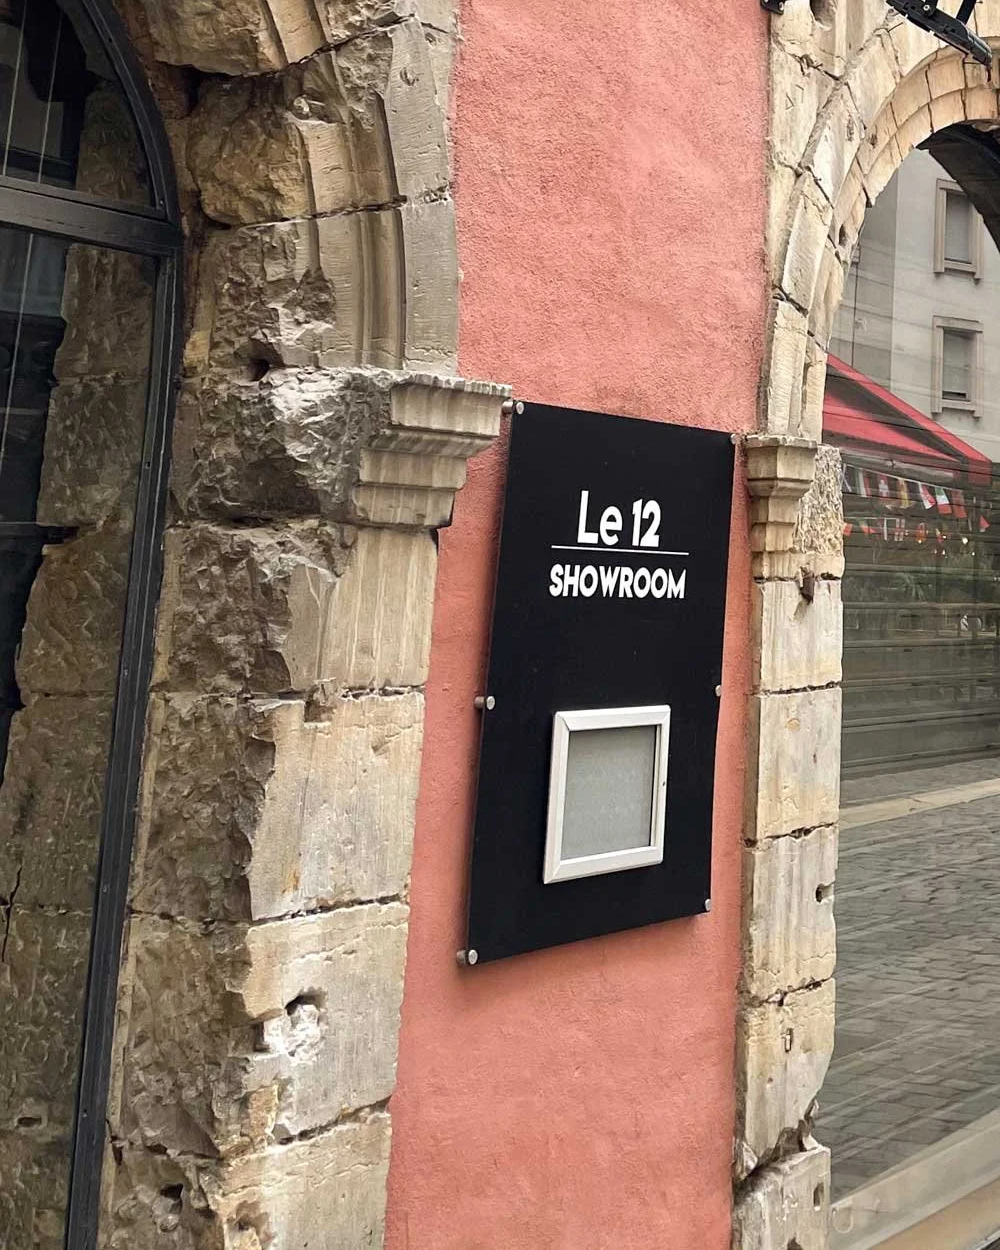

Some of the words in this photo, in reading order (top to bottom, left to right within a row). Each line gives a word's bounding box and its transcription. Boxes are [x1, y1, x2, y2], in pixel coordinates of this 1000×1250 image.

[577, 489, 623, 546] Le
[632, 498, 661, 548] 12
[549, 563, 687, 599] SHOWROOM
